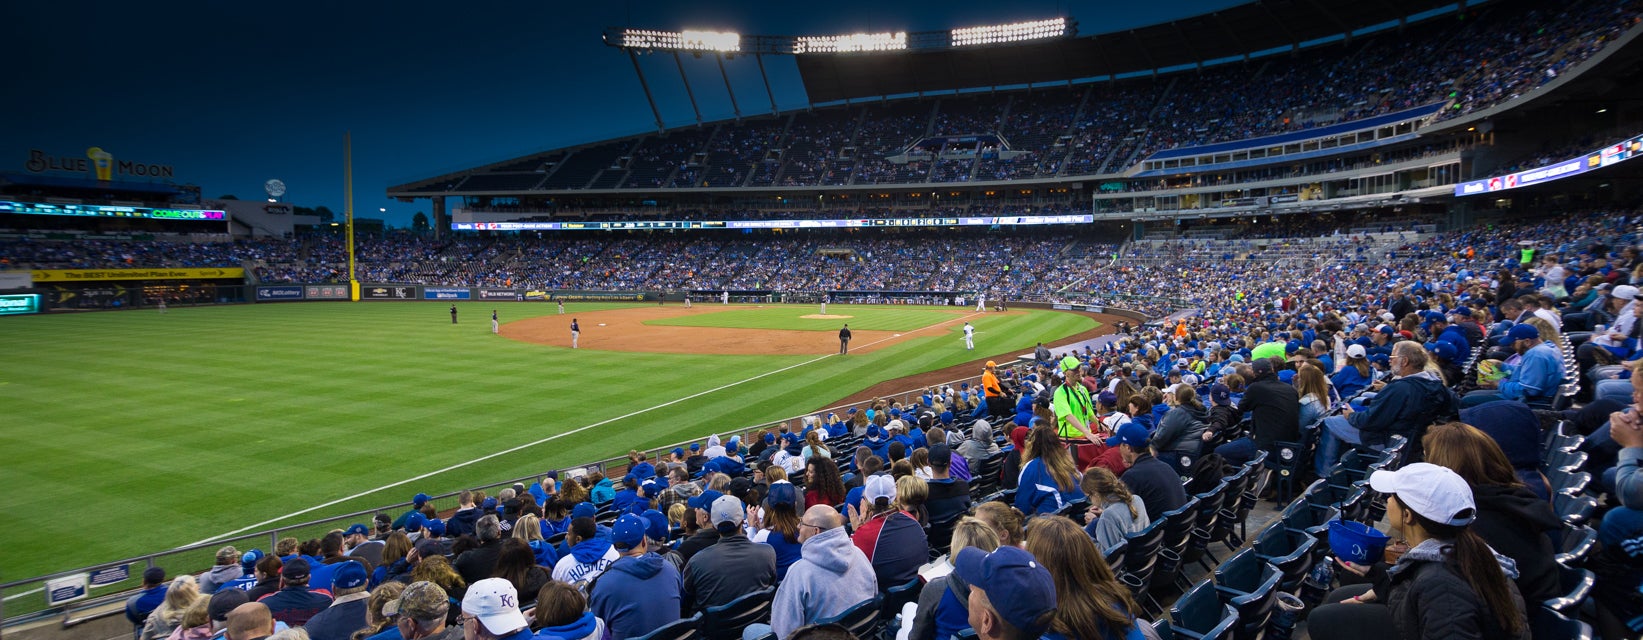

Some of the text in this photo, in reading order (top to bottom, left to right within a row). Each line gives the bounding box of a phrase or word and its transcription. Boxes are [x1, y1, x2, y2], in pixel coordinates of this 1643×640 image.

[26, 150, 173, 177] BLUE MOON
[500, 594, 515, 608] KC
